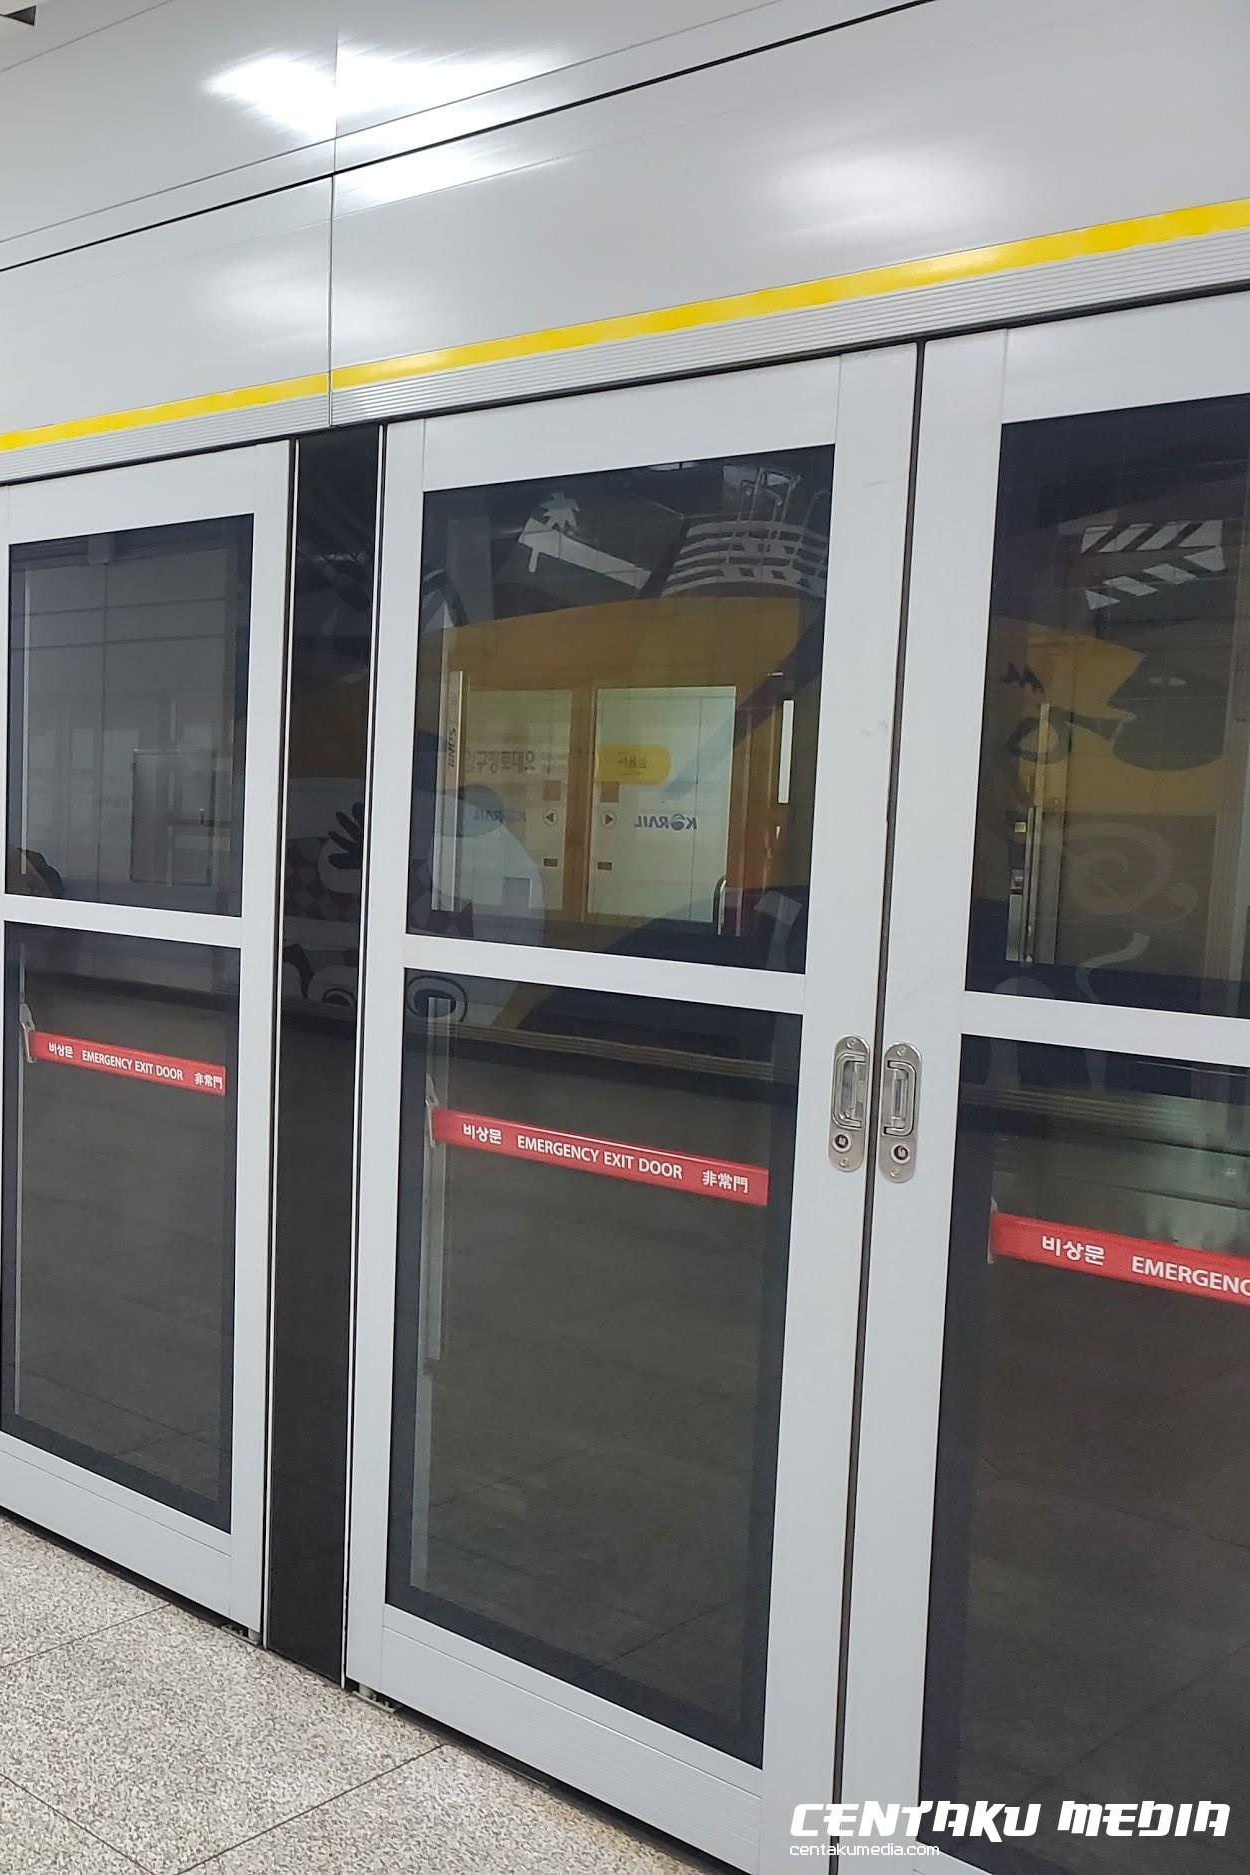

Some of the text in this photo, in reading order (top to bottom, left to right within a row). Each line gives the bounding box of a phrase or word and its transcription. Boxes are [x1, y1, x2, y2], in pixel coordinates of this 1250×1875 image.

[48, 1042, 223, 1090] 비상문 EMERGENCY EXIT DOOR 非常門
[463, 1123, 749, 1194] 비상문 EMERGENCY EXIT DOOR 非常門
[1041, 1235, 1106, 1266] 비상문
